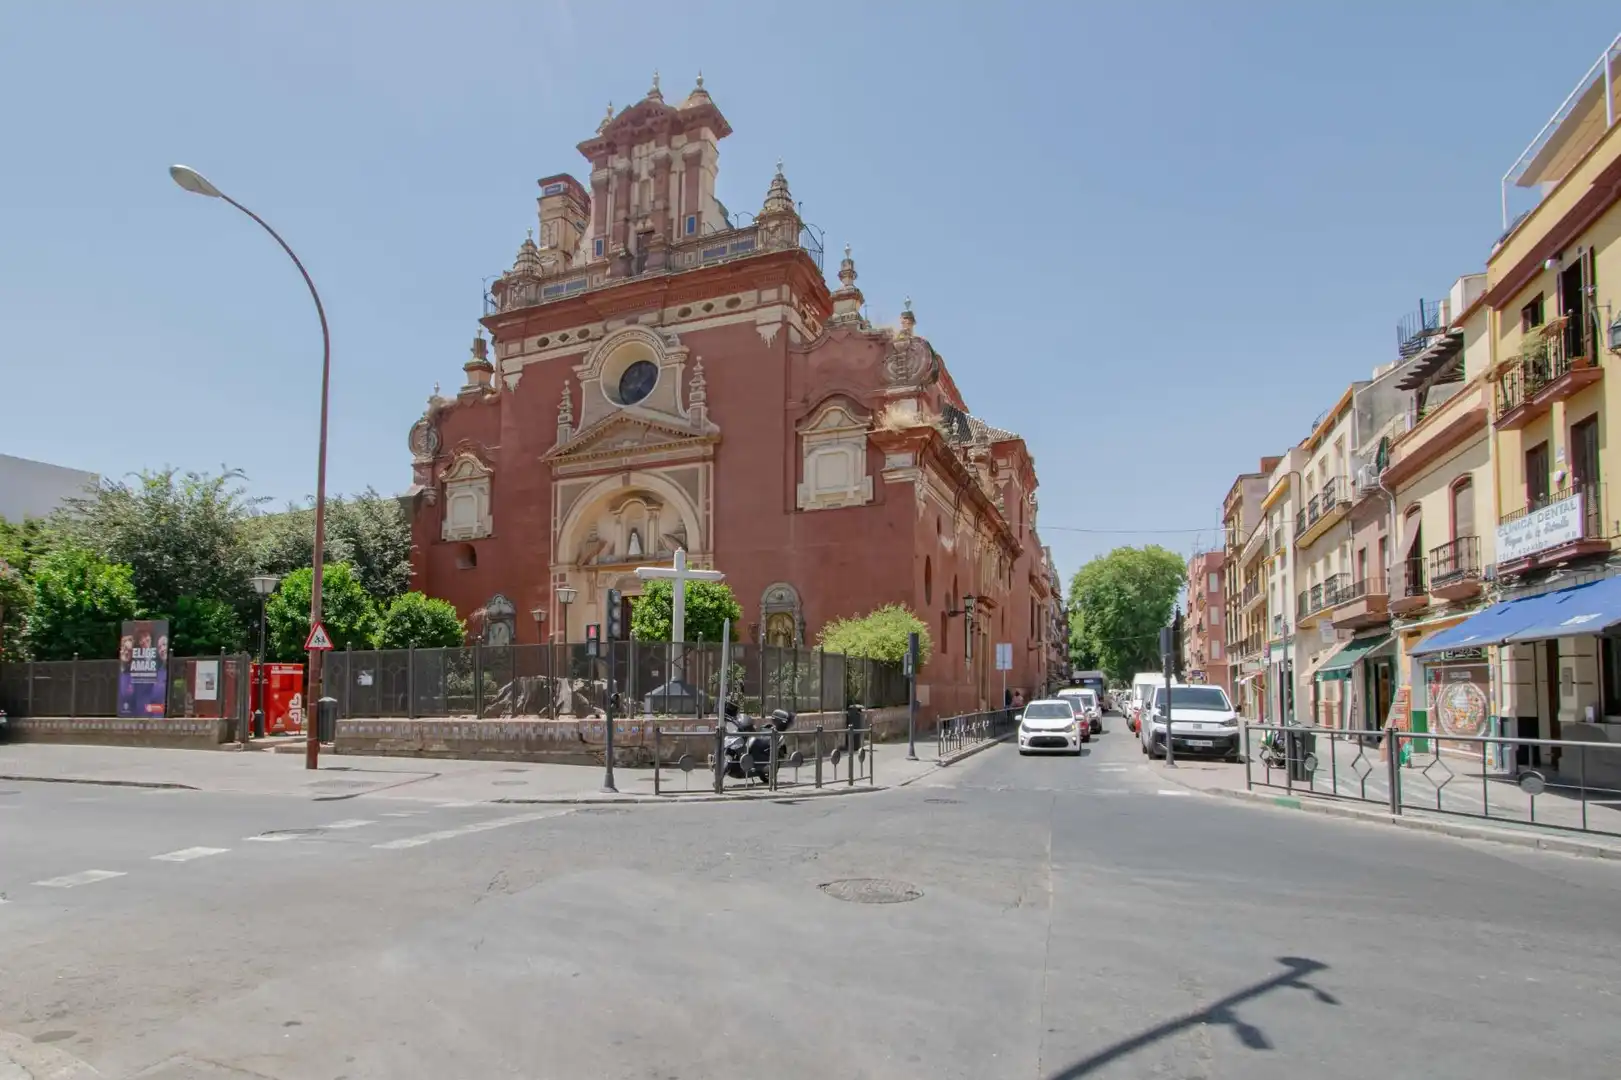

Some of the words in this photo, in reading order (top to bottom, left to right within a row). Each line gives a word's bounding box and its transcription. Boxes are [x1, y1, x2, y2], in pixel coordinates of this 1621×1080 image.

[1537, 500, 1577, 523] DENTAL
[132, 647, 156, 658] ELIGE
[130, 660, 156, 671] AMAR
